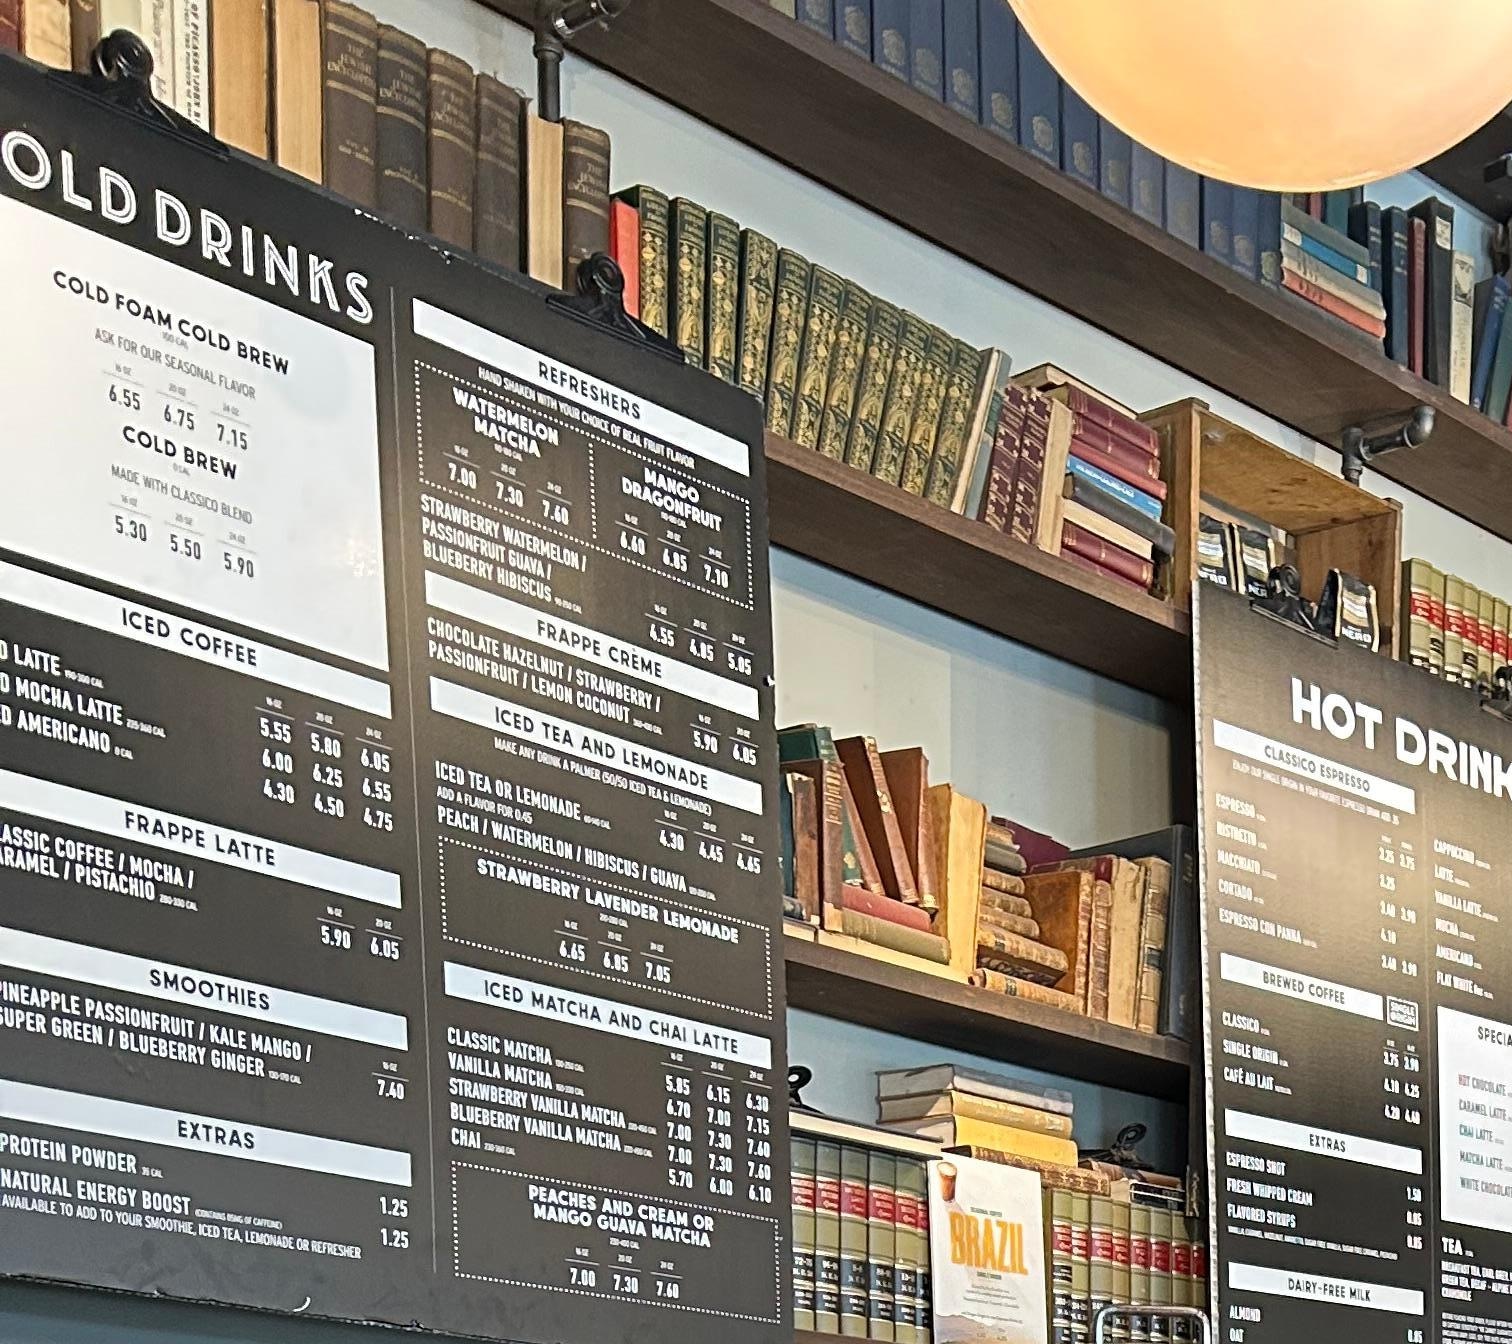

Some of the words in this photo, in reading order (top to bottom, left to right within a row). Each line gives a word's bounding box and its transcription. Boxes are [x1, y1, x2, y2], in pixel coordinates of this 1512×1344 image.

[0, 130, 138, 225] OLD
[155, 188, 373, 325] DRINKS
[53, 270, 109, 305] COLD
[114, 294, 172, 331] FOAM
[178, 318, 230, 352] COLD
[237, 342, 289, 376] BREW
[95, 327, 115, 347] ASK
[117, 335, 138, 355] FOR
[140, 342, 162, 362] OUR
[164, 348, 216, 386] SEASONAL
[218, 369, 257, 400] FLAVOR
[452, 386, 559, 446] WATERMELON
[538, 360, 642, 421] REFRESHERS
[108, 384, 141, 411] 6.55
[163, 404, 195, 432] 6.75
[216, 423, 248, 451] 7.15
[474, 416, 542, 458] MATCHA
[122, 425, 177, 457] COLD
[183, 446, 237, 480] BREW
[111, 463, 140, 487] MADE
[142, 475, 169, 497] WITH
[170, 484, 219, 514] CLASSICO
[221, 501, 253, 525] BLEND
[621, 476, 722, 532] DRAGONFRUIT
[644, 467, 700, 504] MANGO
[114, 514, 148, 542] 5.30
[169, 533, 201, 561] 5.50
[223, 551, 255, 579] 5.90
[420, 493, 500, 538] STRAWBERRY
[502, 522, 580, 569] WATERMELON
[422, 515, 506, 562] PASSIONFRUIT
[508, 547, 546, 575] GUAVA
[422, 541, 494, 582] BLUEBERRY
[496, 566, 552, 602] HIBISCUS
[14, 644, 61, 677] LATTE
[121, 607, 170, 639] ICED
[180, 627, 257, 667] COFFEE
[537, 619, 601, 657] FRAPPE
[608, 641, 662, 679] CRÈME
[427, 617, 500, 657] CHOCOLATE
[503, 640, 564, 680] HAZELNUT
[576, 662, 652, 710] STRAWBERRY
[428, 639, 519, 688] PASSIONFRUIT
[531, 672, 573, 706] LEMON
[576, 689, 631, 723] COCONUT
[16, 675, 73, 712] MOCHA
[77, 692, 123, 726] LATTE
[1290, 676, 1383, 751] HOT
[17, 710, 111, 754] AMERICANO
[259, 716, 292, 744] 5.55
[495, 705, 535, 737] ICED
[542, 720, 573, 748] TEA
[581, 733, 616, 759] AND
[623, 747, 708, 791] LEMONADE
[435, 760, 465, 787] ICED
[468, 770, 493, 794] TEA
[495, 779, 513, 799] OR
[516, 785, 581, 822] LEMONADE
[1264, 744, 1317, 775] CLASSICO
[1319, 760, 1371, 793] ESPRESSO
[124, 811, 206, 849] FRAPPE
[214, 832, 276, 867] LATTE
[363, 806, 394, 832] 4.75
[53, 836, 115, 870] COFFEE
[129, 854, 184, 888] MOCHA
[437, 805, 480, 834] PEACH
[492, 821, 573, 862] WATERMELON
[584, 846, 639, 880] HIBISCUS
[650, 866, 687, 893] GUAVA
[74, 863, 155, 901] PISTACHIO
[476, 858, 581, 901] STRAWBERRY
[585, 887, 659, 922] LAVENDER
[663, 909, 739, 944] LEMONADE
[320, 925, 352, 950] 5.90
[149, 968, 271, 1011] SMOOTHIES
[1263, 970, 1305, 994] BREWED
[1308, 983, 1345, 1005] COFFEE
[84, 995, 195, 1040] PASSIONFRUIT
[209, 1024, 248, 1051] KALE
[251, 1034, 302, 1063] MANGO
[484, 979, 523, 1003] ICED
[531, 991, 601, 1022] MATCHA
[608, 1010, 642, 1032] AND
[649, 1019, 687, 1042] CHAI
[694, 1029, 738, 1054] LATTE
[1222, 1011, 1260, 1034] CLASSICO
[51, 1016, 104, 1045] GREEN
[118, 1029, 206, 1067] BLUEBERRY
[210, 1049, 266, 1078] GINGER
[447, 1027, 501, 1054] CLASSIC
[503, 1039, 553, 1066] MATCHA
[448, 1052, 502, 1080] VANILLA
[504, 1064, 553, 1090] MATCHA
[377, 1078, 405, 1101] 7.40
[0, 1132, 67, 1163] PROTEIN
[71, 1145, 138, 1174] POWDER
[177, 1119, 255, 1150] EXTRAS
[451, 1127, 481, 1149] CHAI
[1309, 1133, 1346, 1153] EXTRAS
[0, 1167, 73, 1198] NATURAL
[77, 1179, 137, 1208] ENERGY
[141, 1189, 191, 1216] BOOST
[379, 1196, 409, 1218] 1.25
[528, 1184, 597, 1211] PEACHES
[601, 1198, 633, 1217] AND
[638, 1204, 688, 1227] CREAM
[692, 1214, 714, 1233] OR
[1227, 1204, 1266, 1224] FLAVORED
[1, 1193, 58, 1215] AVAILABLE
[59, 1202, 74, 1217] TO
[75, 1205, 98, 1220] ADD
[99, 1208, 114, 1223] TO
[116, 1209, 143, 1229] YOUR
[198, 1222, 220, 1241] ICED
[221, 1226, 243, 1244] TEA,
[245, 1229, 295, 1251] LEMONADE
[296, 1237, 309, 1252] OR
[311, 1239, 362, 1260] REFRESHER
[380, 1227, 409, 1250] 1.25
[533, 1202, 592, 1227] MANGO
[597, 1214, 647, 1238] GUAVA
[651, 1223, 712, 1248] MATCHA
[949, 1211, 1028, 1276] BRAZIL
[1442, 1236, 1463, 1256] TEA
[1288, 1277, 1346, 1299] DAIRY-FREE
[1349, 1287, 1371, 1301] MILK
